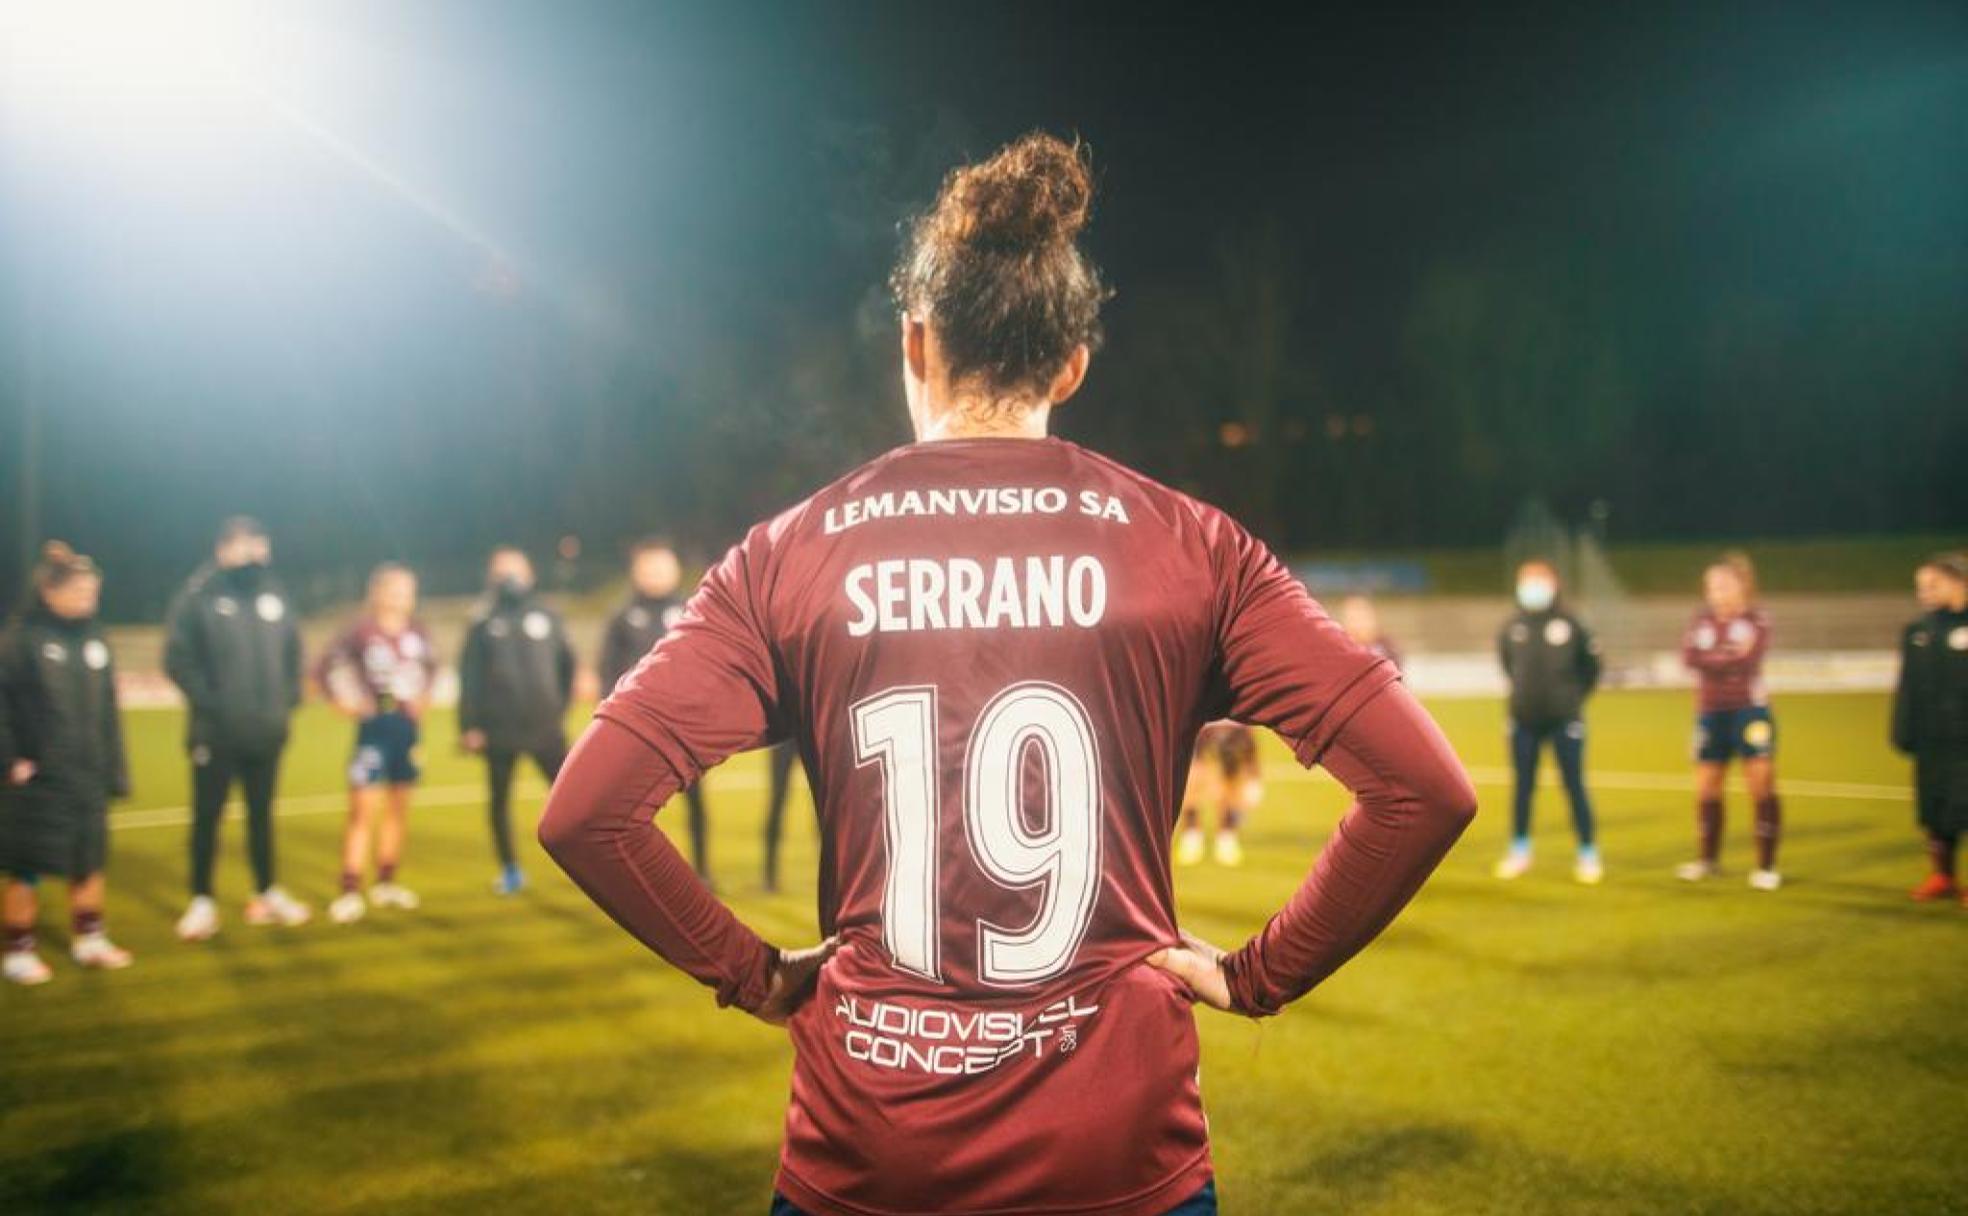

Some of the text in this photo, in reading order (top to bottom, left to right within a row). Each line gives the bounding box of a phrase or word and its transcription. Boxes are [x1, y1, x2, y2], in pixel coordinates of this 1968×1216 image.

[824, 487, 1130, 534] LEMANVISIO SA
[845, 555, 1106, 637] SERRANO
[849, 680, 1103, 987] 19
[845, 1029, 1054, 1075] CONCEPT
